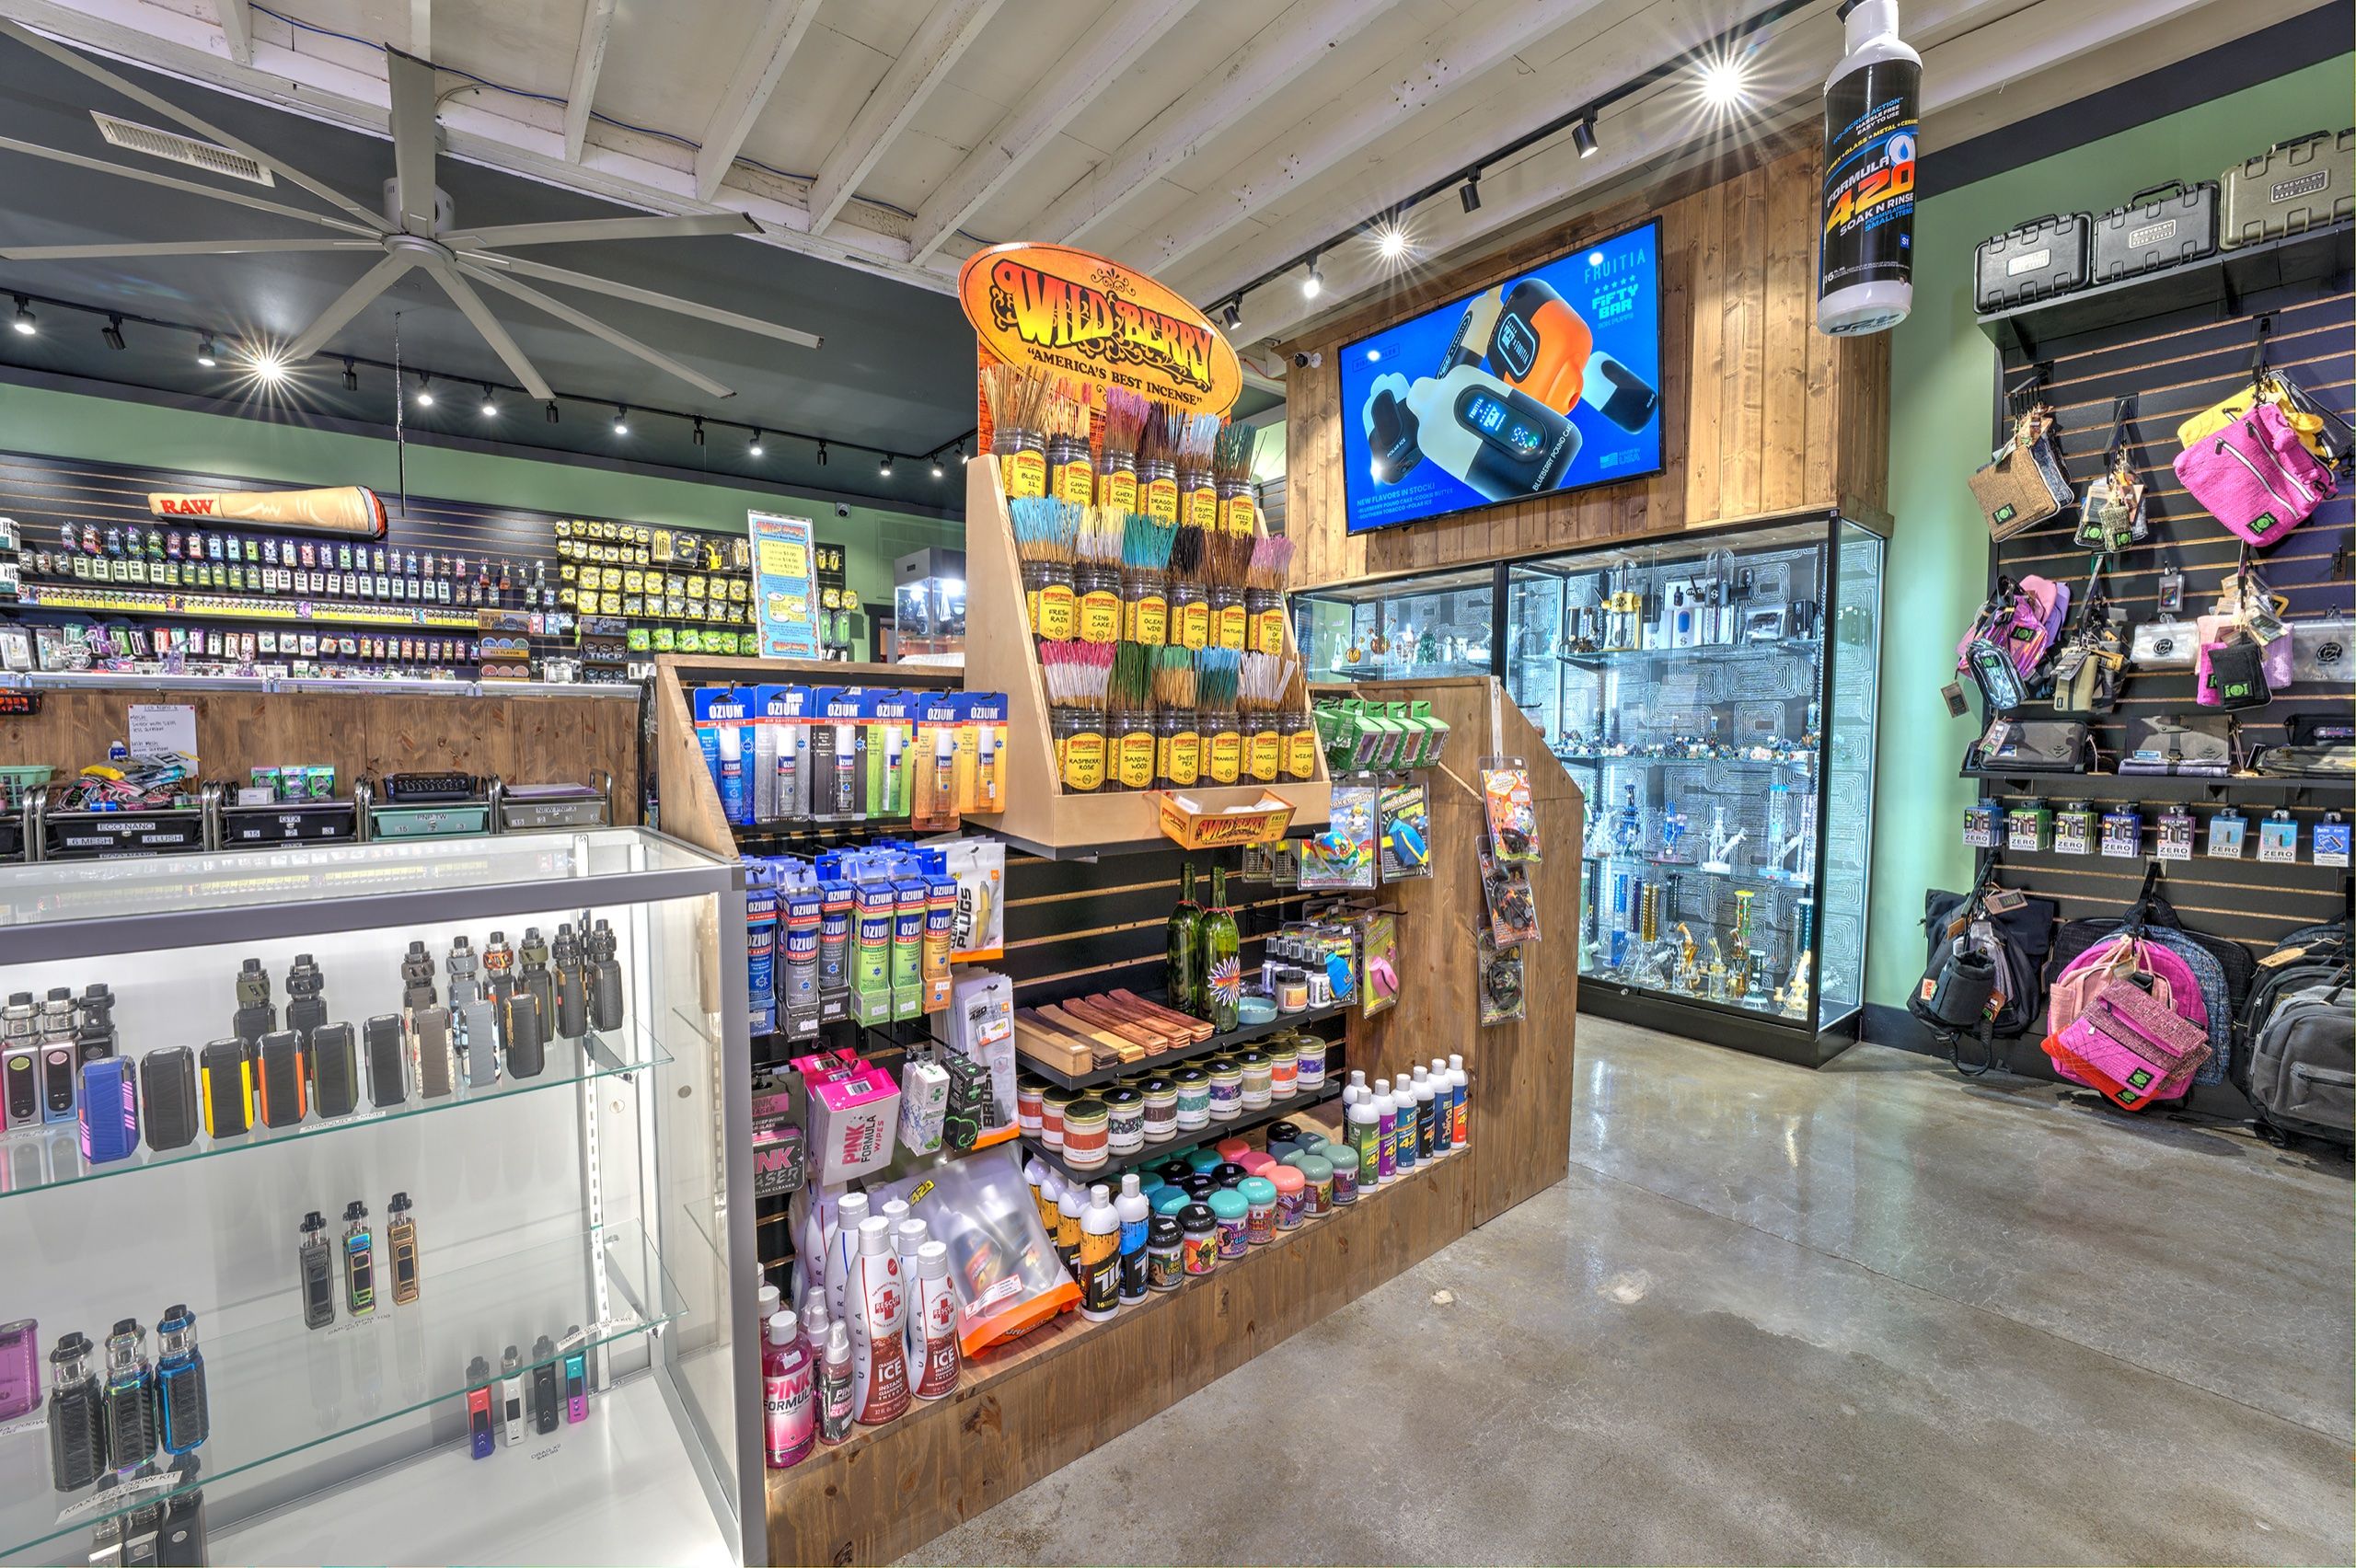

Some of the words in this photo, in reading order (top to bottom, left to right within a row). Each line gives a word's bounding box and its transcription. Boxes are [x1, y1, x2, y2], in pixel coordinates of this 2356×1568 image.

[1856, 112, 1883, 131] HASSLE
[1884, 105, 1900, 115] FREE
[1857, 122, 1876, 135] EASY
[1877, 116, 1886, 124] TO
[1887, 110, 1900, 120] USE
[1844, 137, 1868, 156] GLASS
[1873, 124, 1896, 137] METAL
[1827, 155, 1890, 209] FORMULA
[1826, 160, 1914, 234] 420
[1840, 208, 1874, 236] SOAK
[1876, 202, 1885, 213] N
[1887, 192, 1914, 209] RINSE
[1865, 213, 1895, 233] SMALL
[1585, 248, 1646, 283] FRUITIA
[1824, 271, 1834, 284] 16
[1599, 297, 1632, 319] BAR
[991, 259, 1113, 348] WILD
[1116, 301, 1216, 386] BERRY
[1112, 371, 1142, 389] BEST
[1387, 444, 1400, 458] POLAR
[1532, 457, 1553, 492] BLUEBERRY
[1551, 437, 1566, 458] POUND
[1564, 422, 1574, 439] CAKE
[1357, 494, 1372, 506] NEW
[1372, 489, 1401, 503] FLAVORS
[1401, 488, 1408, 496] IN
[1408, 482, 1436, 495] STOCK!
[160, 499, 215, 514] RAW
[589, 651, 623, 661] THCP
[709, 705, 744, 720] OZIUM
[768, 702, 801, 717] OZIUM
[827, 704, 859, 718] OZIUM
[876, 705, 906, 718] OZIUM
[928, 708, 954, 721] OZIUM
[971, 708, 998, 720] OZIUM
[1381, 784, 1425, 811] smokebuddy
[1195, 818, 1234, 842] WILD
[1235, 815, 1269, 836] BERRY
[81, 837, 111, 846] MESH
[828, 890, 852, 902] OZIUM
[869, 894, 893, 905] OZIUM
[902, 890, 924, 901] OZIUM
[933, 885, 955, 896] OZIUM
[748, 901, 775, 913] OZIUM
[792, 905, 819, 916] OZIUM
[957, 887, 972, 949] PLUGS
[842, 1124, 865, 1165] PINK
[861, 1114, 876, 1163] FORMULA
[874, 1120, 884, 1153] WIPES
[772, 1183, 795, 1193] CLEANER
[910, 1180, 935, 1206] 420
[875, 1295, 901, 1310] RESCUE
[932, 1303, 953, 1316] RESCUE
[854, 1312, 865, 1379] ULTRA
[917, 1311, 925, 1368] ULTRA
[933, 1348, 955, 1369] ICE
[878, 1361, 902, 1383] ICE
[768, 1367, 811, 1399] PINK
[878, 1377, 903, 1391] INSTANT
[531, 1446, 552, 1459] DRAG
[65, 1489, 112, 1515] MAXUS
[123, 1476, 156, 1488] 200W
[159, 1472, 178, 1482] KIT
